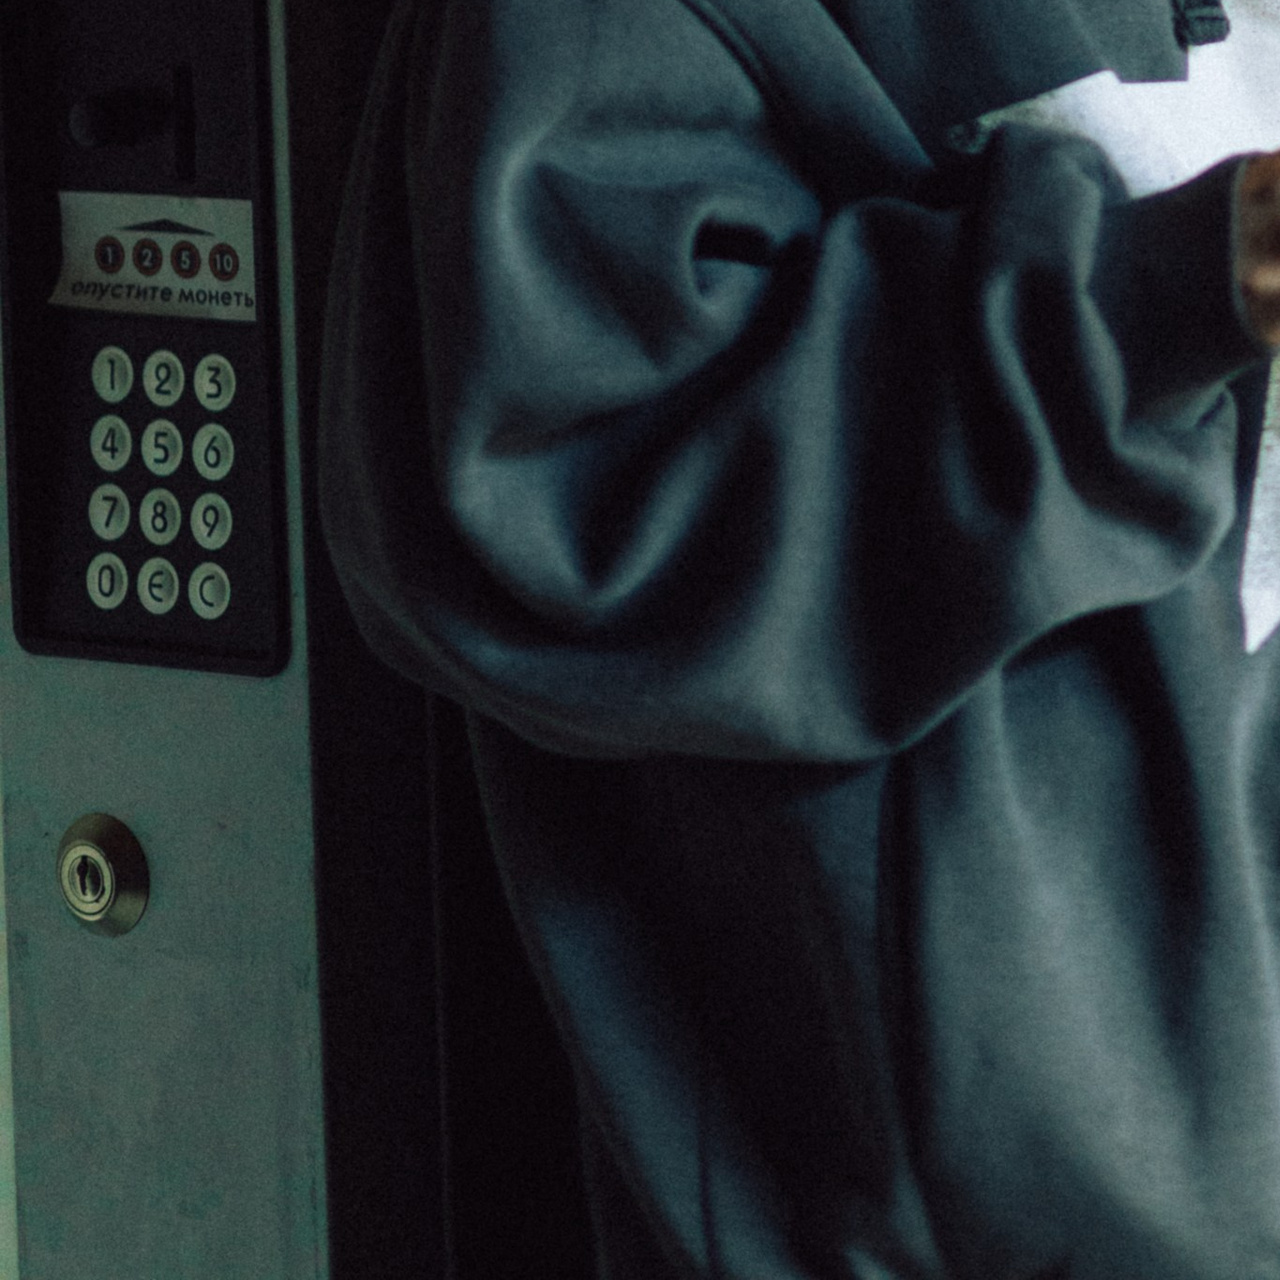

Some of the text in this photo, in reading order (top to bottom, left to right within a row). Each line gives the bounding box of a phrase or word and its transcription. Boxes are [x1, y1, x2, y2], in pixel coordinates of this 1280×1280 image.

[142, 249, 151, 267] 2
[181, 251, 190, 269] 5
[215, 254, 233, 272] 10
[71, 281, 172, 302] опустите
[107, 358, 222, 399] 1 2 3
[101, 427, 221, 469] 4 5 6
[102, 495, 220, 538] 7 8 9
